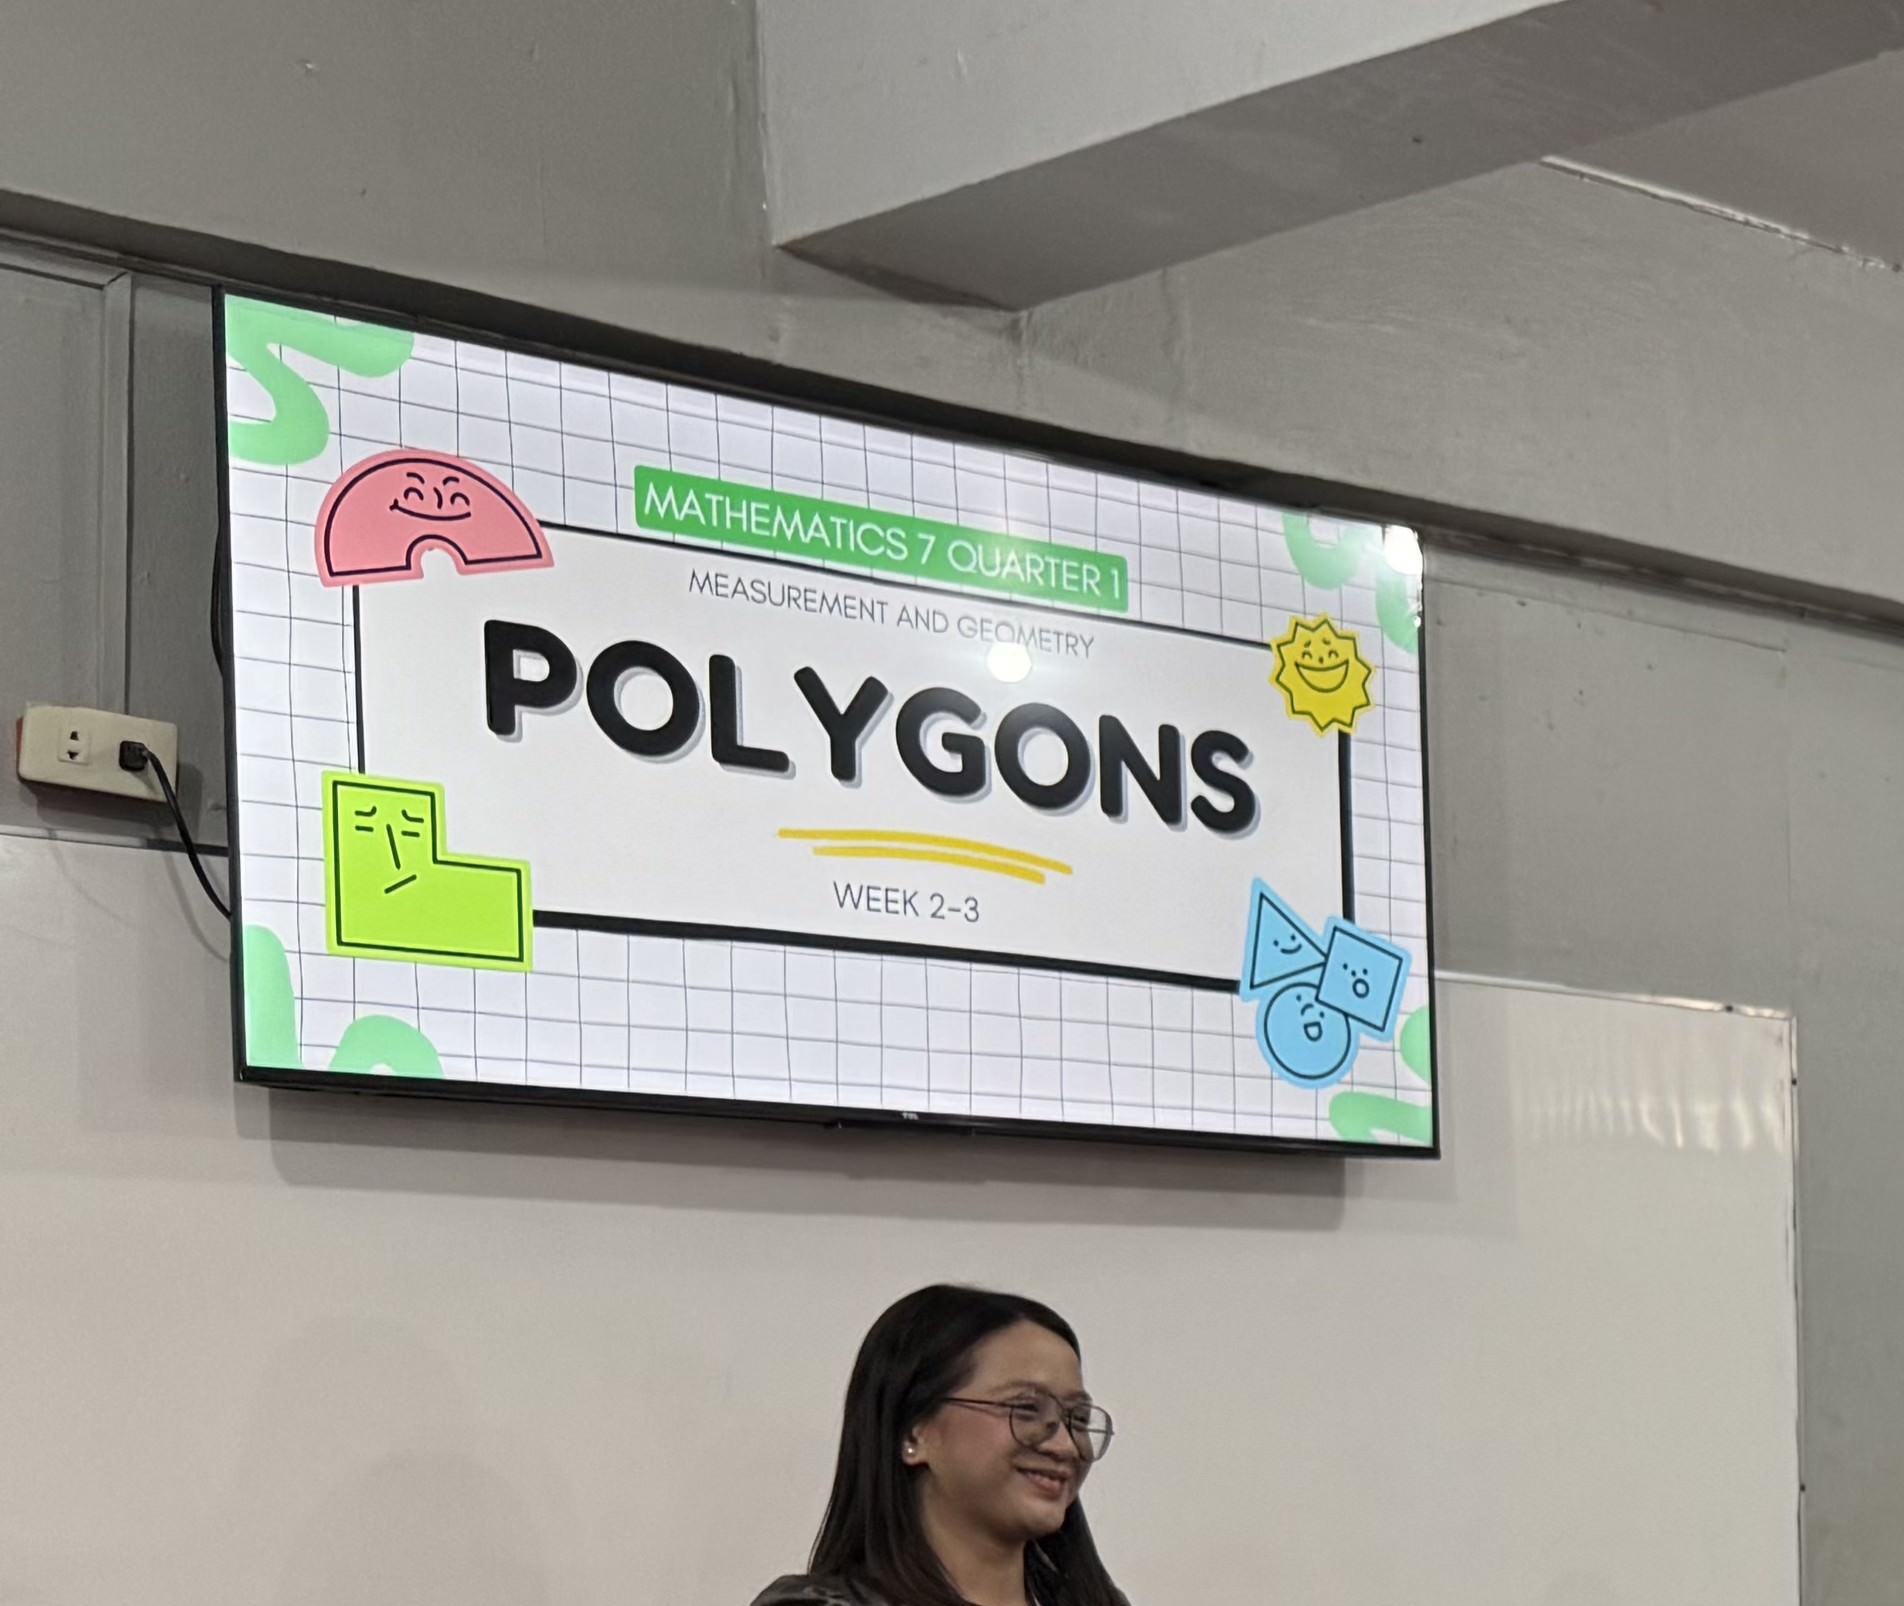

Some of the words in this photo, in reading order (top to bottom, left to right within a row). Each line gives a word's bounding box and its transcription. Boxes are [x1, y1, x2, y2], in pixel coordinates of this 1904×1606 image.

[643, 481, 909, 561] MATHEMATICS
[917, 533, 937, 565] 7
[948, 539, 1102, 596] QUARTER
[1110, 567, 1121, 600] 1
[688, 568, 888, 624] MEASUREMENT
[896, 604, 949, 634] AND
[956, 614, 1095, 659] GEOMETRY
[483, 618, 1259, 837] POLYGONS
[832, 880, 920, 918] WEEK
